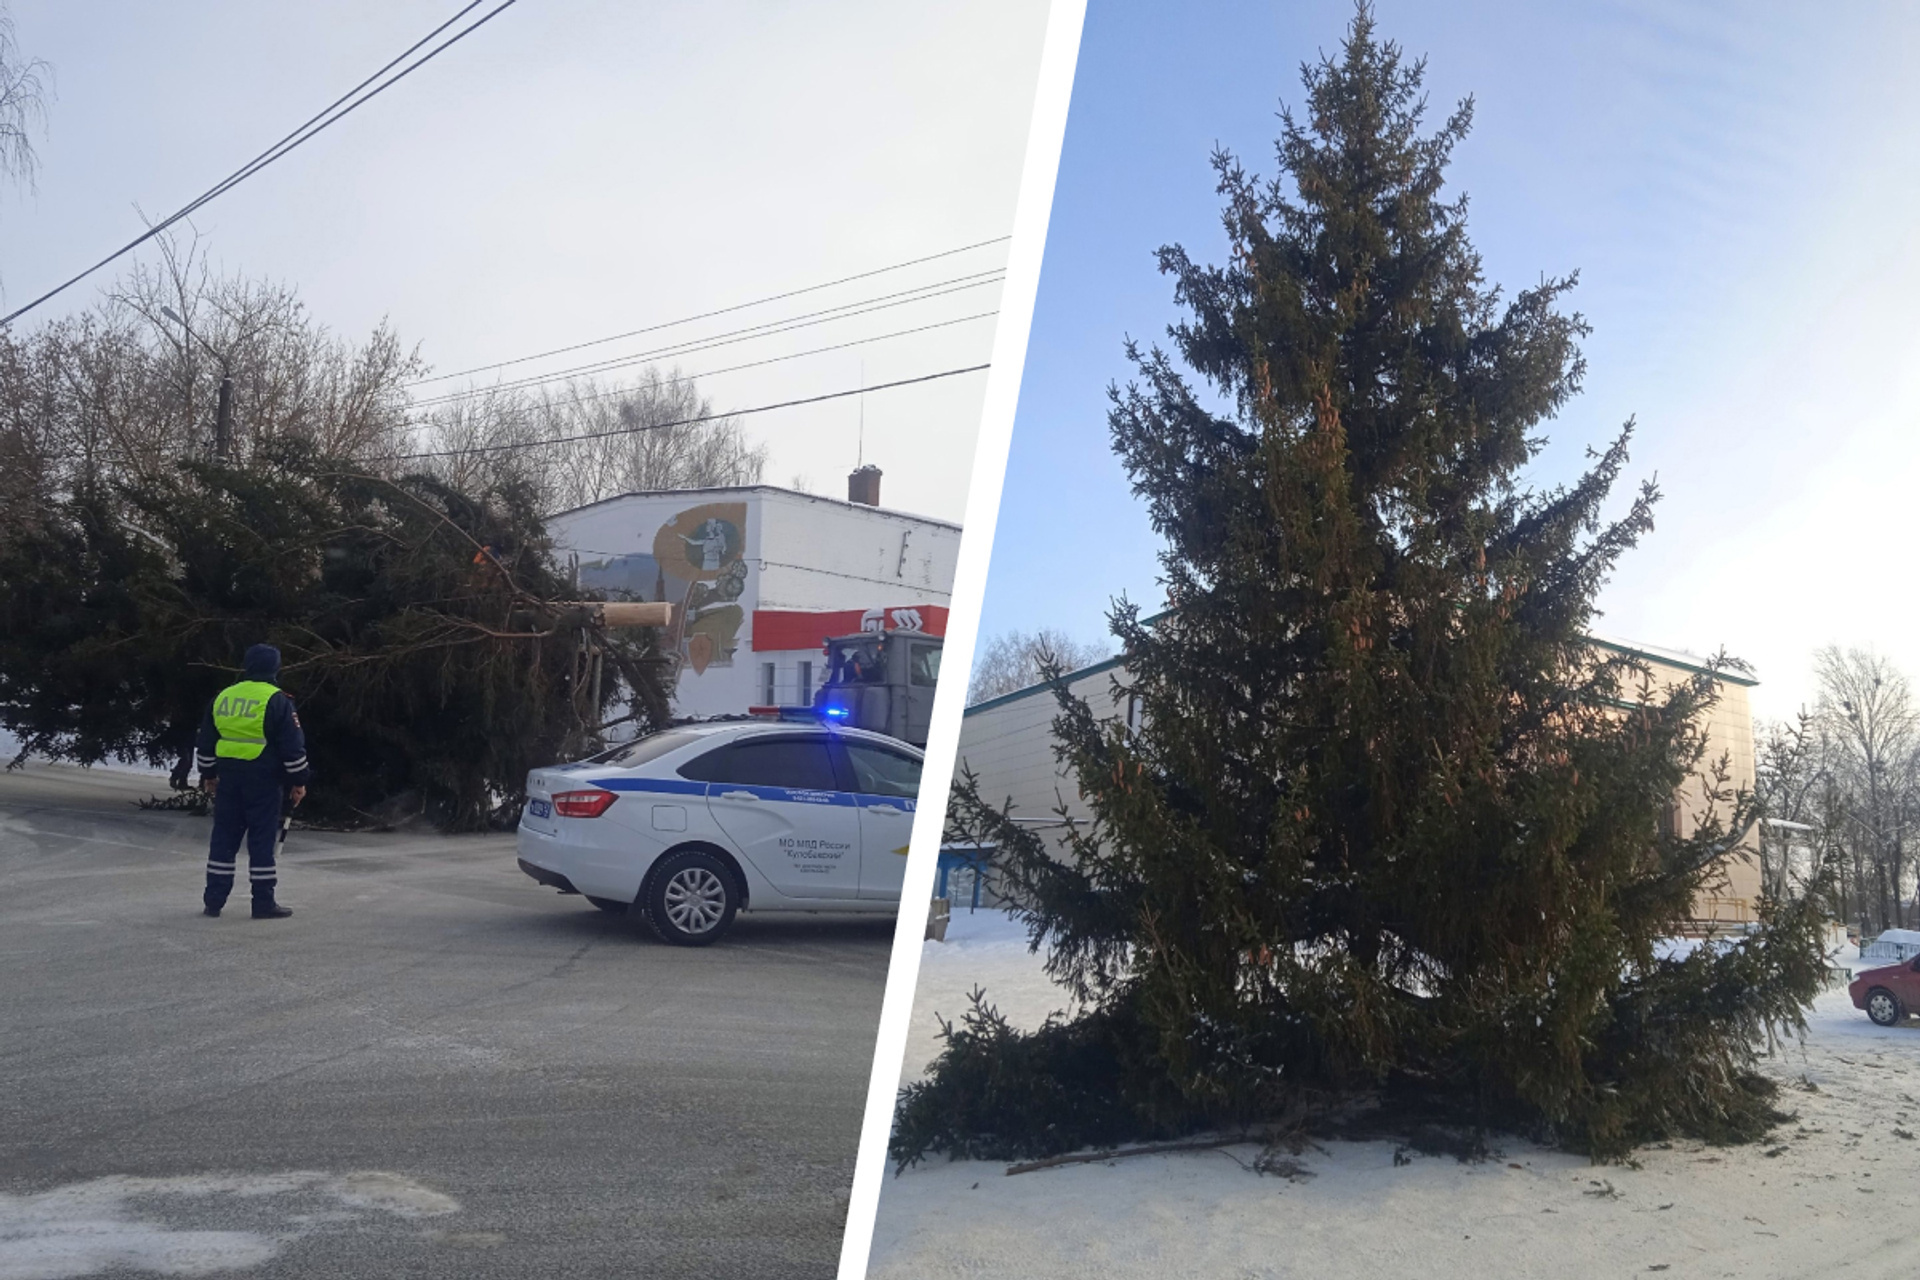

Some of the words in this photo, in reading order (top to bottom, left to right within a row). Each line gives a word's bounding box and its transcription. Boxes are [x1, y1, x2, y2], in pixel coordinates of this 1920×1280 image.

[216, 696, 260, 718] ДПС
[779, 838, 795, 848] МО
[797, 839, 817, 849] МВД
[819, 840, 851, 850] России
